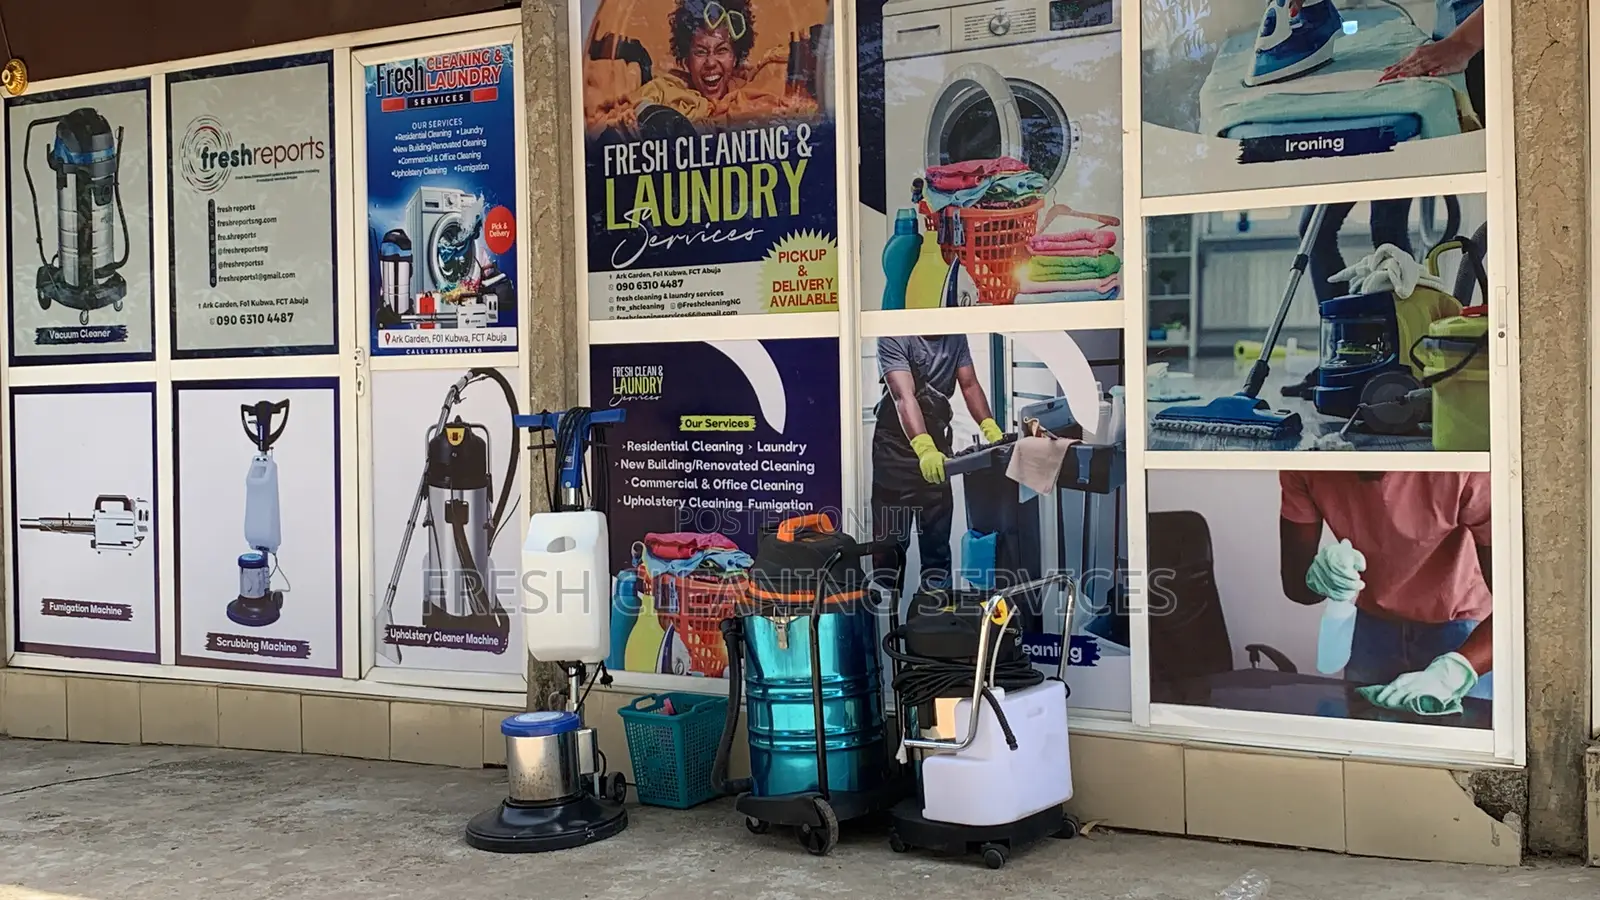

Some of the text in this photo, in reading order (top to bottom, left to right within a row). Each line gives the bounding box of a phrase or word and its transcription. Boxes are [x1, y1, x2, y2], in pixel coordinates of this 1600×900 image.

[426, 49, 503, 71] CLEANING &
[376, 58, 425, 96] Fresh
[426, 64, 503, 91] LAUNDRY
[414, 93, 464, 106] SERVICES
[412, 118, 463, 130] OUR SERVICES
[398, 126, 484, 140] Residential Cleaning Laundry
[462, 138, 487, 148] Cleaning
[603, 123, 813, 176] FRESH CLEANING &
[1285, 136, 1345, 152] Ironing
[201, 136, 325, 170] freshreports
[401, 150, 482, 164] Commercial & Office Cleaning
[394, 163, 490, 178] Upholstery Cleaning Fumigation
[605, 159, 809, 231] LAUNDRY
[217, 204, 256, 213] fresh reports
[217, 216, 278, 228] freshreportsng.com
[492, 222, 508, 230] Pick &
[489, 230, 510, 238] Delivery
[611, 206, 765, 269] Services
[778, 248, 827, 264] PICKUP
[689, 268, 701, 276] FCT
[702, 267, 722, 276] Abuja
[798, 264, 808, 276] &
[616, 278, 684, 292] 090 6310 4487
[772, 277, 834, 293] DELIVERY
[276, 298, 288, 306] FCT
[289, 297, 309, 306] Abuja
[634, 293, 662, 302] cleaning
[668, 291, 696, 300] laundry
[696, 290, 724, 298] services
[770, 292, 838, 308] AVAILABLE
[616, 303, 665, 312] fre_shcleaning
[677, 298, 741, 309] @FreshcleaningNG
[216, 312, 295, 326] 090 6310 4487
[49, 328, 111, 340] Vacuum Cleaner
[392, 334, 404, 344] Ark
[404, 334, 431, 344] Garden,
[444, 334, 470, 343] Kubwa,
[471, 333, 485, 342] FCT
[486, 333, 508, 344] Abuja
[612, 365, 664, 377] FRESH CLEAN &
[612, 376, 664, 394] LAUNDRY
[608, 386, 662, 407] Services
[684, 418, 750, 428] Our Services
[626, 441, 807, 456] Residential Cleaning Laundry
[620, 458, 816, 475] New Building/Renovated Cleaning
[630, 477, 804, 494] Commercial & Office Cleaning
[622, 495, 814, 514] Upholstery Cleaining Fumigation
[48, 602, 122, 616] Fumigation Machine
[216, 636, 298, 652] Scrubbing Machine
[390, 628, 500, 646] Upholstery Cleaner Machine
